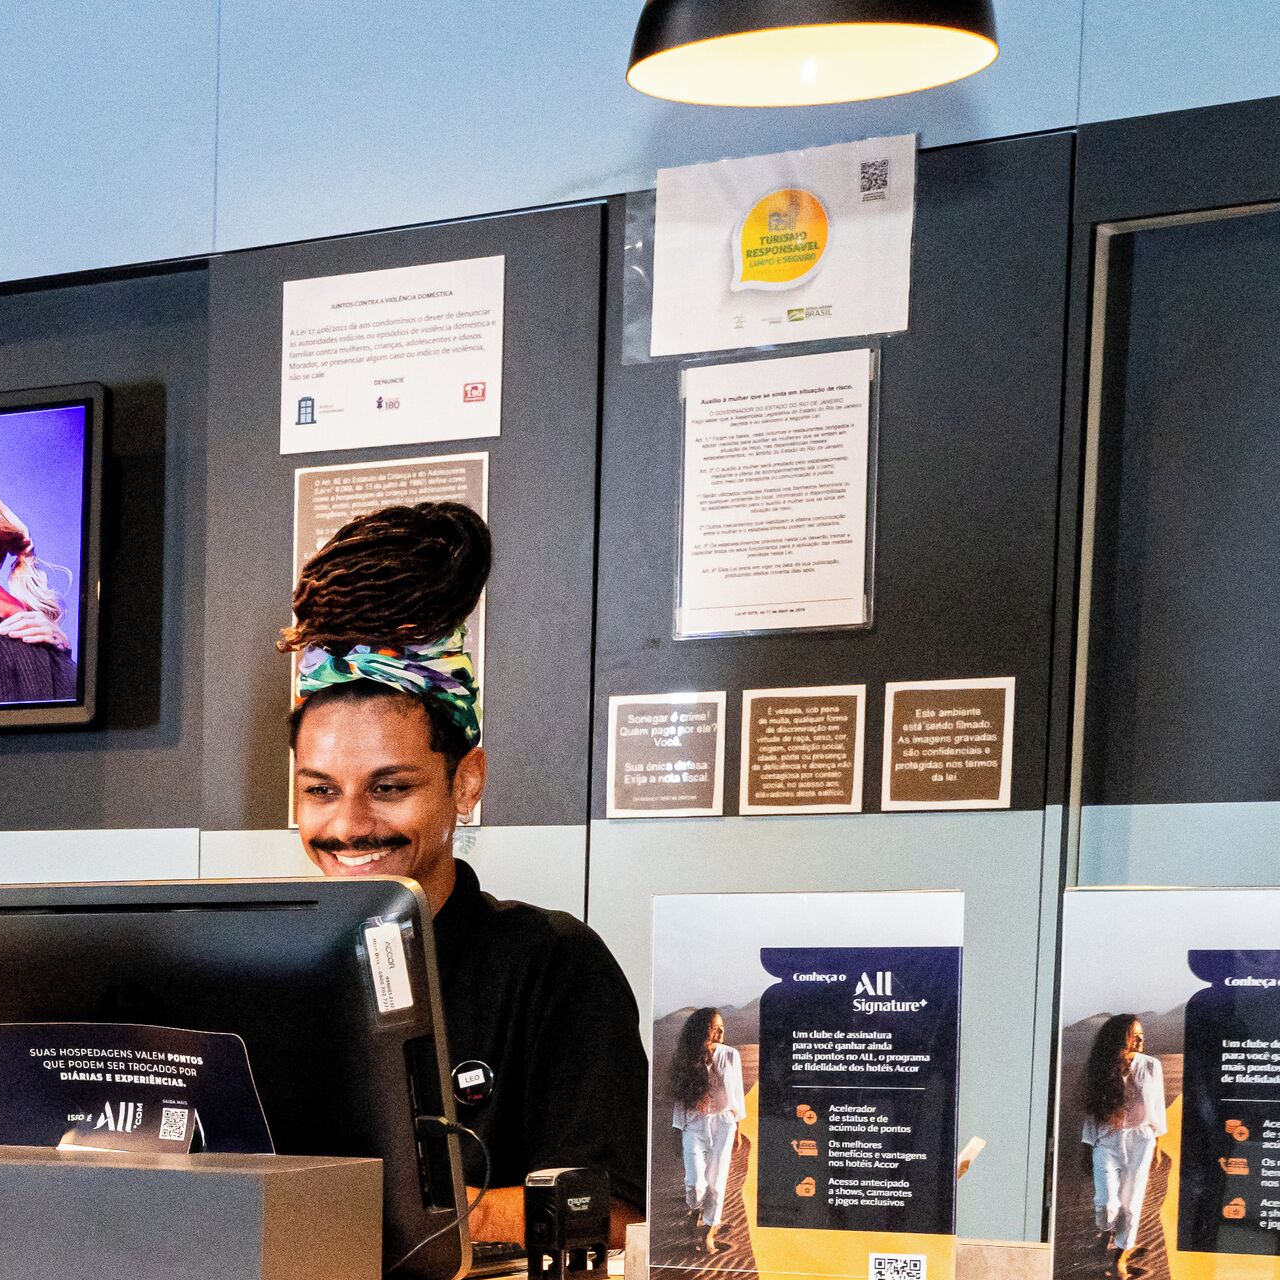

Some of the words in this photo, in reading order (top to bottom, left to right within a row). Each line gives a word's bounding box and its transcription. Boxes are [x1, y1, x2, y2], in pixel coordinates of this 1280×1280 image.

[760, 232, 807, 245] TURISMO
[805, 309, 832, 318] BRASIL
[466, 389, 482, 398] 190
[385, 401, 400, 410] 180
[627, 714, 668, 725] Sonegar
[670, 711, 678, 722] é
[915, 709, 936, 718] Este
[939, 708, 981, 717] ambiente
[620, 726, 648, 737] Quem
[651, 726, 676, 737] paga
[677, 725, 694, 736] por
[696, 723, 718, 733] ele?
[903, 722, 922, 731] está
[926, 721, 954, 730] sendo
[956, 720, 992, 729] filmado.
[654, 736, 682, 747] Você.
[898, 736, 910, 744] As
[913, 735, 951, 745] imagens
[954, 733, 997, 744] gravadas
[903, 748, 920, 757] são
[922, 747, 982, 756] confidenciais
[624, 762, 644, 772] Sua
[646, 761, 673, 771] única
[895, 761, 943, 771] protegidas
[965, 760, 998, 768] termos
[624, 774, 648, 786] Exija
[658, 774, 680, 783] nota
[385, 941, 395, 969] ACCOR
[793, 972, 838, 984] Conheça
[1224, 976, 1276, 988] Conheça
[853, 972, 892, 996] All
[793, 1031, 808, 1039] Um
[809, 1031, 833, 1039] clube
[834, 1031, 845, 1039] de
[846, 1031, 892, 1039] assinatura
[793, 1042, 812, 1051] para
[814, 1042, 834, 1050] você
[835, 1042, 866, 1051] ganhar
[867, 1042, 892, 1050] ainda
[30, 1048, 56, 1057] SUAS
[59, 1049, 133, 1058] HOSPEDAGENS
[135, 1051, 165, 1061] VALEM
[167, 1054, 203, 1065] PONTOS
[815, 1053, 844, 1062] pontos
[886, 1055, 930, 1063] programa
[43, 1061, 65, 1069] QUE
[69, 1061, 104, 1070] PODEM
[107, 1062, 125, 1070] SER
[128, 1063, 177, 1074] TROCADOS
[179, 1067, 197, 1076] POR
[792, 1063, 803, 1071] de
[804, 1063, 847, 1072] fidelidade
[849, 1064, 864, 1072] dos
[866, 1064, 893, 1072] hotéis
[60, 1071, 103, 1081] DIÁRIAS
[106, 1074, 112, 1082] E
[115, 1074, 186, 1088] EXPERIÊNCIAS.
[465, 1075, 480, 1083] LEO
[829, 1104, 876, 1113] Acelerador
[67, 1114, 85, 1122] ISSO
[87, 1113, 92, 1122] É
[93, 1101, 134, 1133] All
[829, 1114, 840, 1122] de
[842, 1114, 868, 1122] status
[877, 1115, 888, 1123] de
[829, 1123, 866, 1132] acúmulo
[868, 1124, 878, 1132] de
[880, 1125, 911, 1134] pontos
[829, 1140, 840, 1148] Os
[842, 1141, 882, 1149] melhores
[829, 1149, 873, 1158] benefícios
[881, 1152, 927, 1161] vantagens
[846, 1160, 872, 1168] hotéis
[874, 1161, 899, 1169] Accor
[828, 1178, 859, 1186] Acesso
[860, 1179, 909, 1189] antecipado
[835, 1188, 865, 1196] shows,
[866, 1189, 912, 1198] camarotes
[835, 1197, 859, 1206] jogos
[860, 1198, 905, 1206] exclusivos
